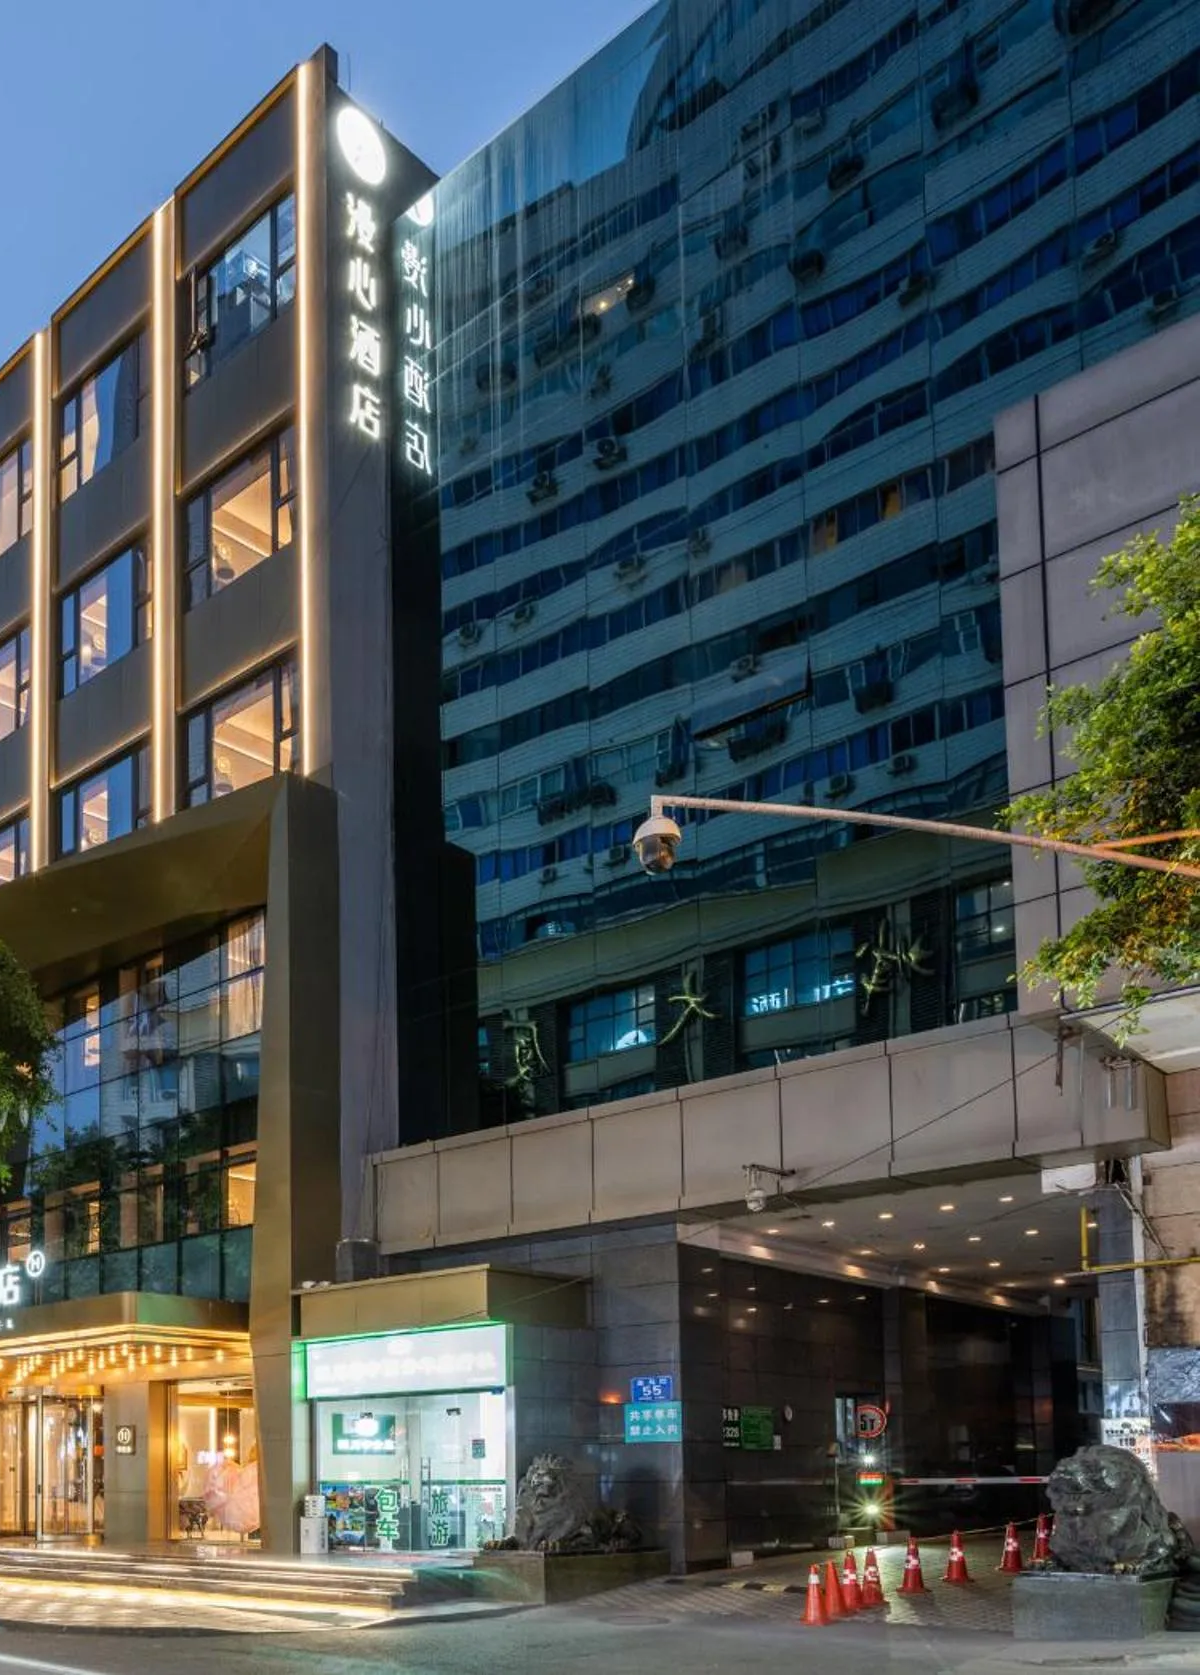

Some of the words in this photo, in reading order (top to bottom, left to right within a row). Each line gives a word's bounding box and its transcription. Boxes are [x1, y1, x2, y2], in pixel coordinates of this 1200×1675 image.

[346, 192, 380, 440] 漫心酒店
[643, 1384, 662, 1396] 55
[376, 1489, 400, 1541] 包车
